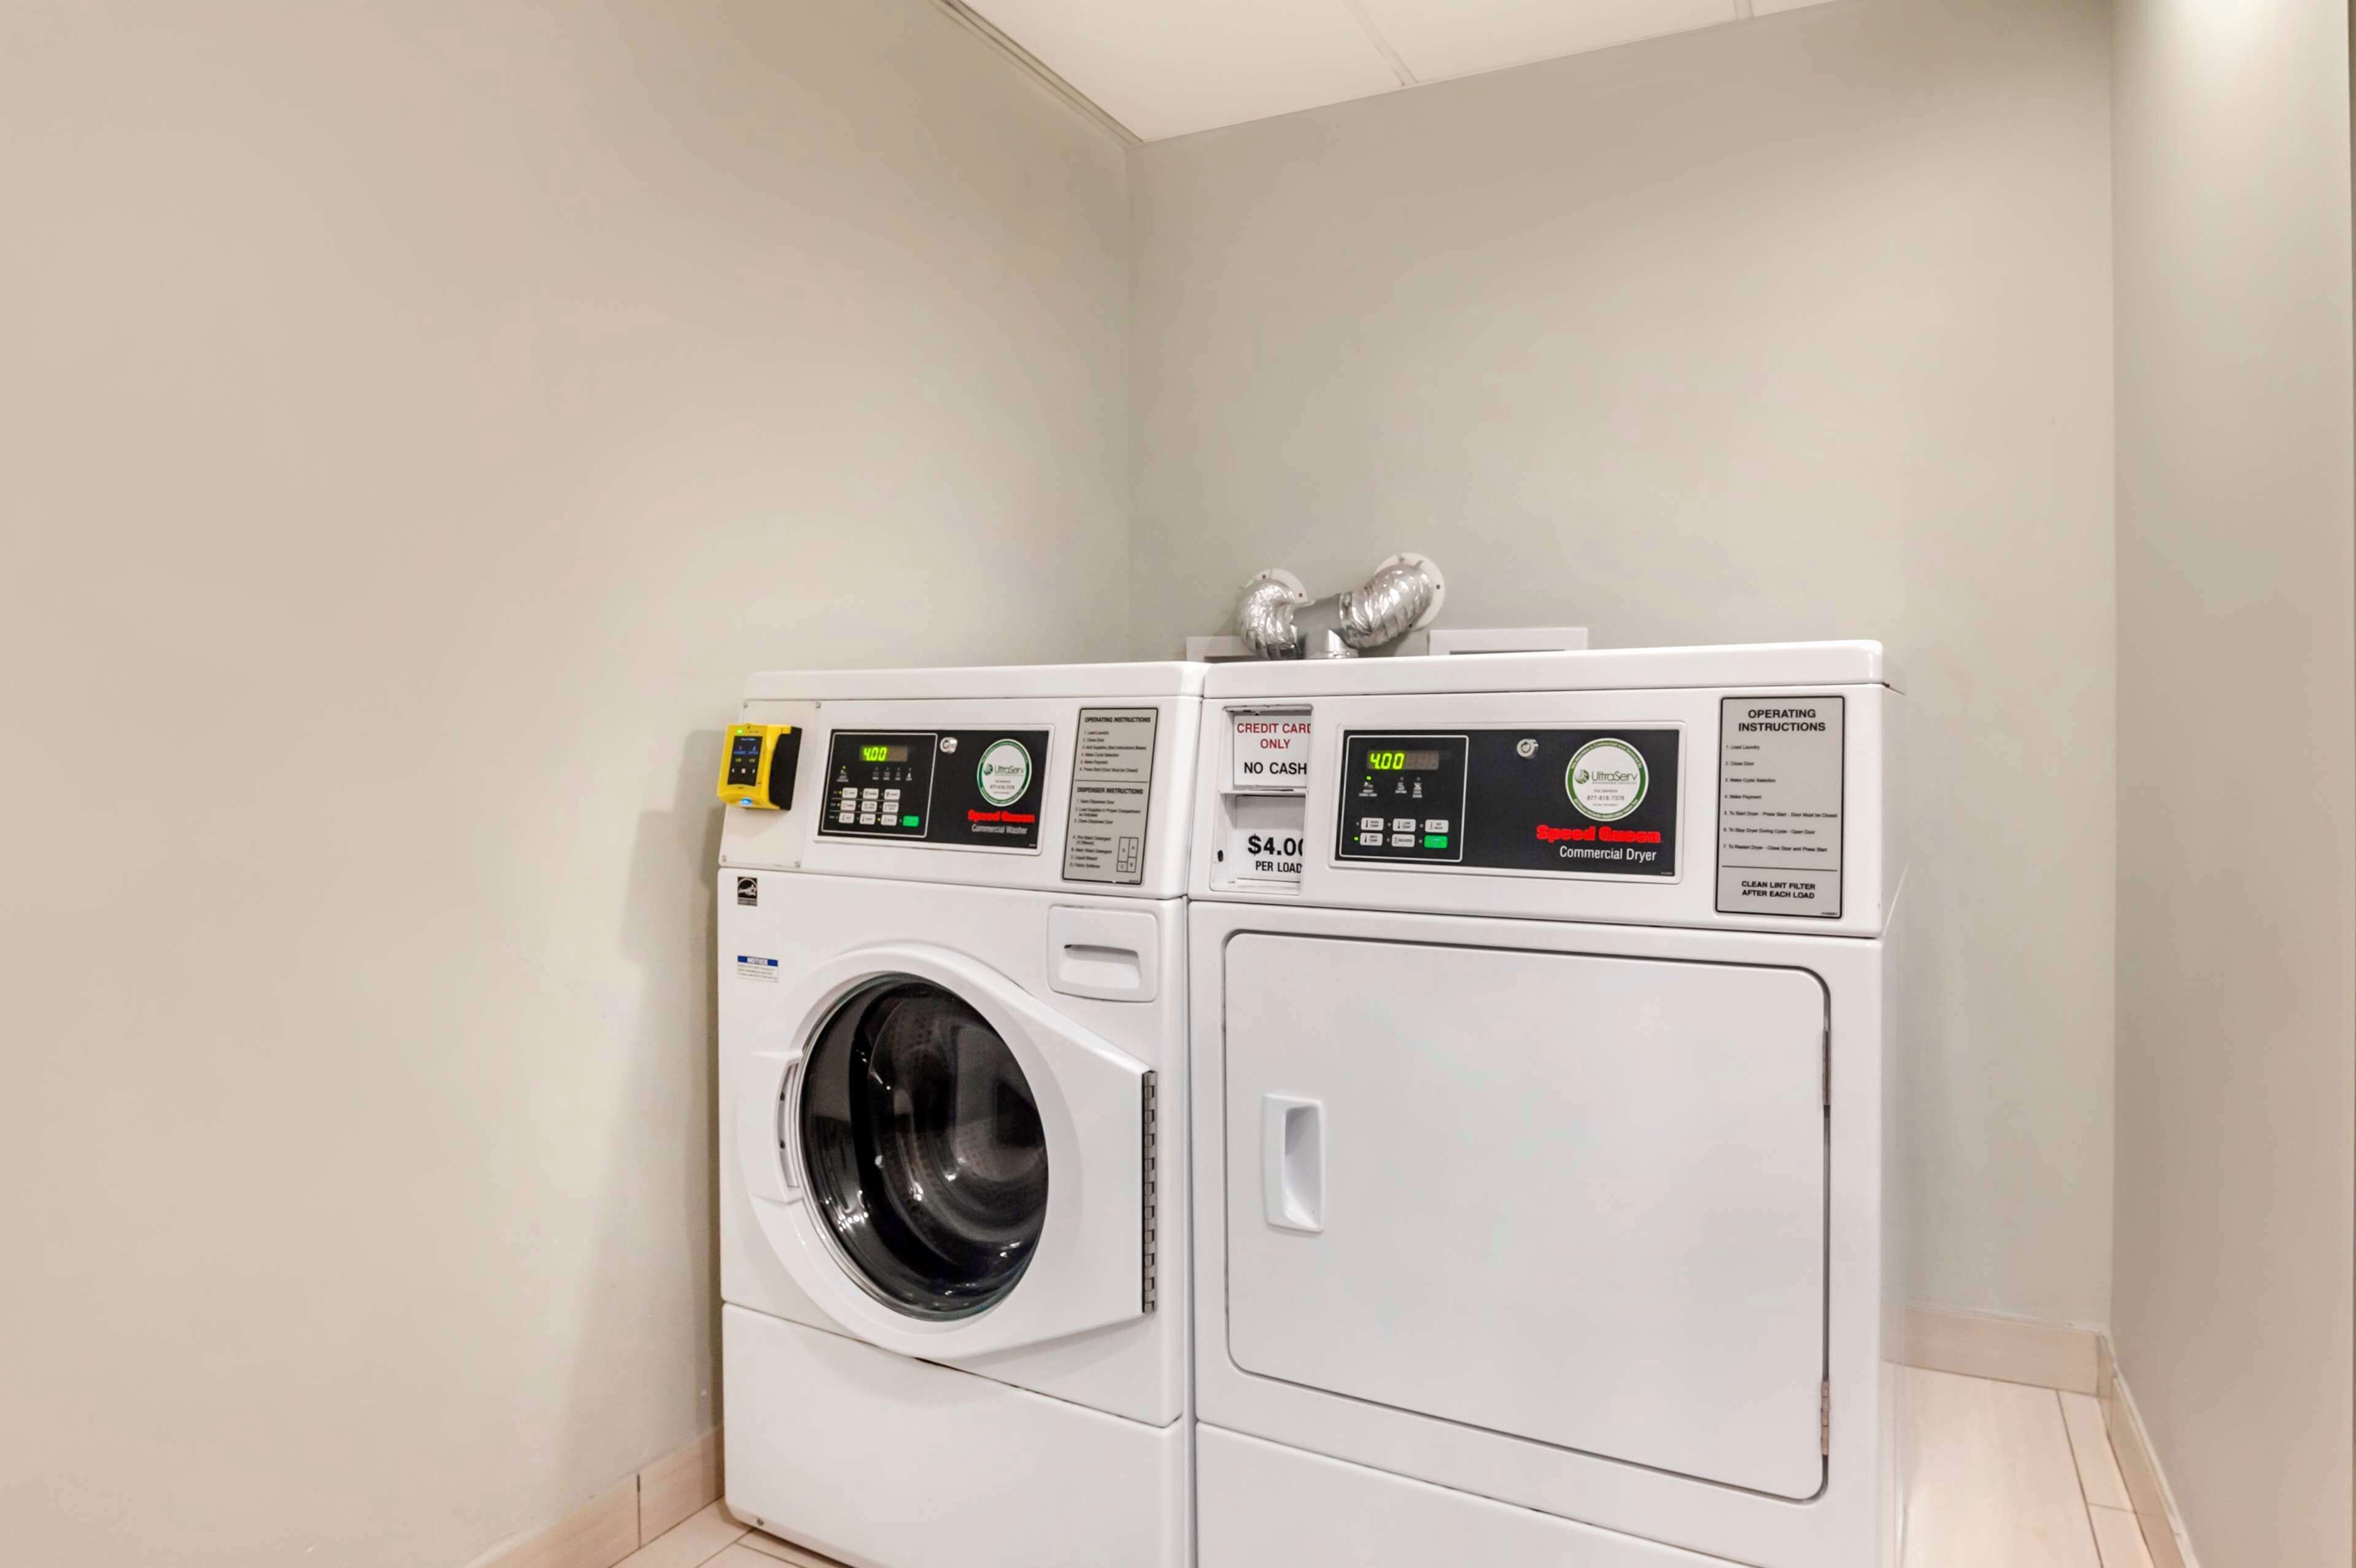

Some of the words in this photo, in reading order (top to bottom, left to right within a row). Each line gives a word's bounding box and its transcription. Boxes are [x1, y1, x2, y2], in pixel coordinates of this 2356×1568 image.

[1748, 709, 1816, 718] OPERATING
[1237, 724, 1279, 733] CREDIT
[1739, 723, 1826, 732] INSTRUCTIONS
[1261, 739, 1290, 749] ONLY
[995, 765, 1025, 774] UltraServ
[1245, 762, 1264, 774] NO
[1270, 762, 1307, 774] CASH
[1592, 771, 1638, 781] UltraServ
[968, 809, 1001, 823] Speed
[1002, 811, 1035, 823] Queen
[972, 824, 1005, 833] Commercial
[1006, 825, 1028, 835] Washer
[1537, 825, 1595, 843] Speed
[1599, 826, 1661, 843] Queen
[1560, 846, 1623, 860] Commercial
[1626, 848, 1657, 863] Dryer
[1256, 861, 1273, 871] PER
[1278, 862, 1302, 873] LOAD
